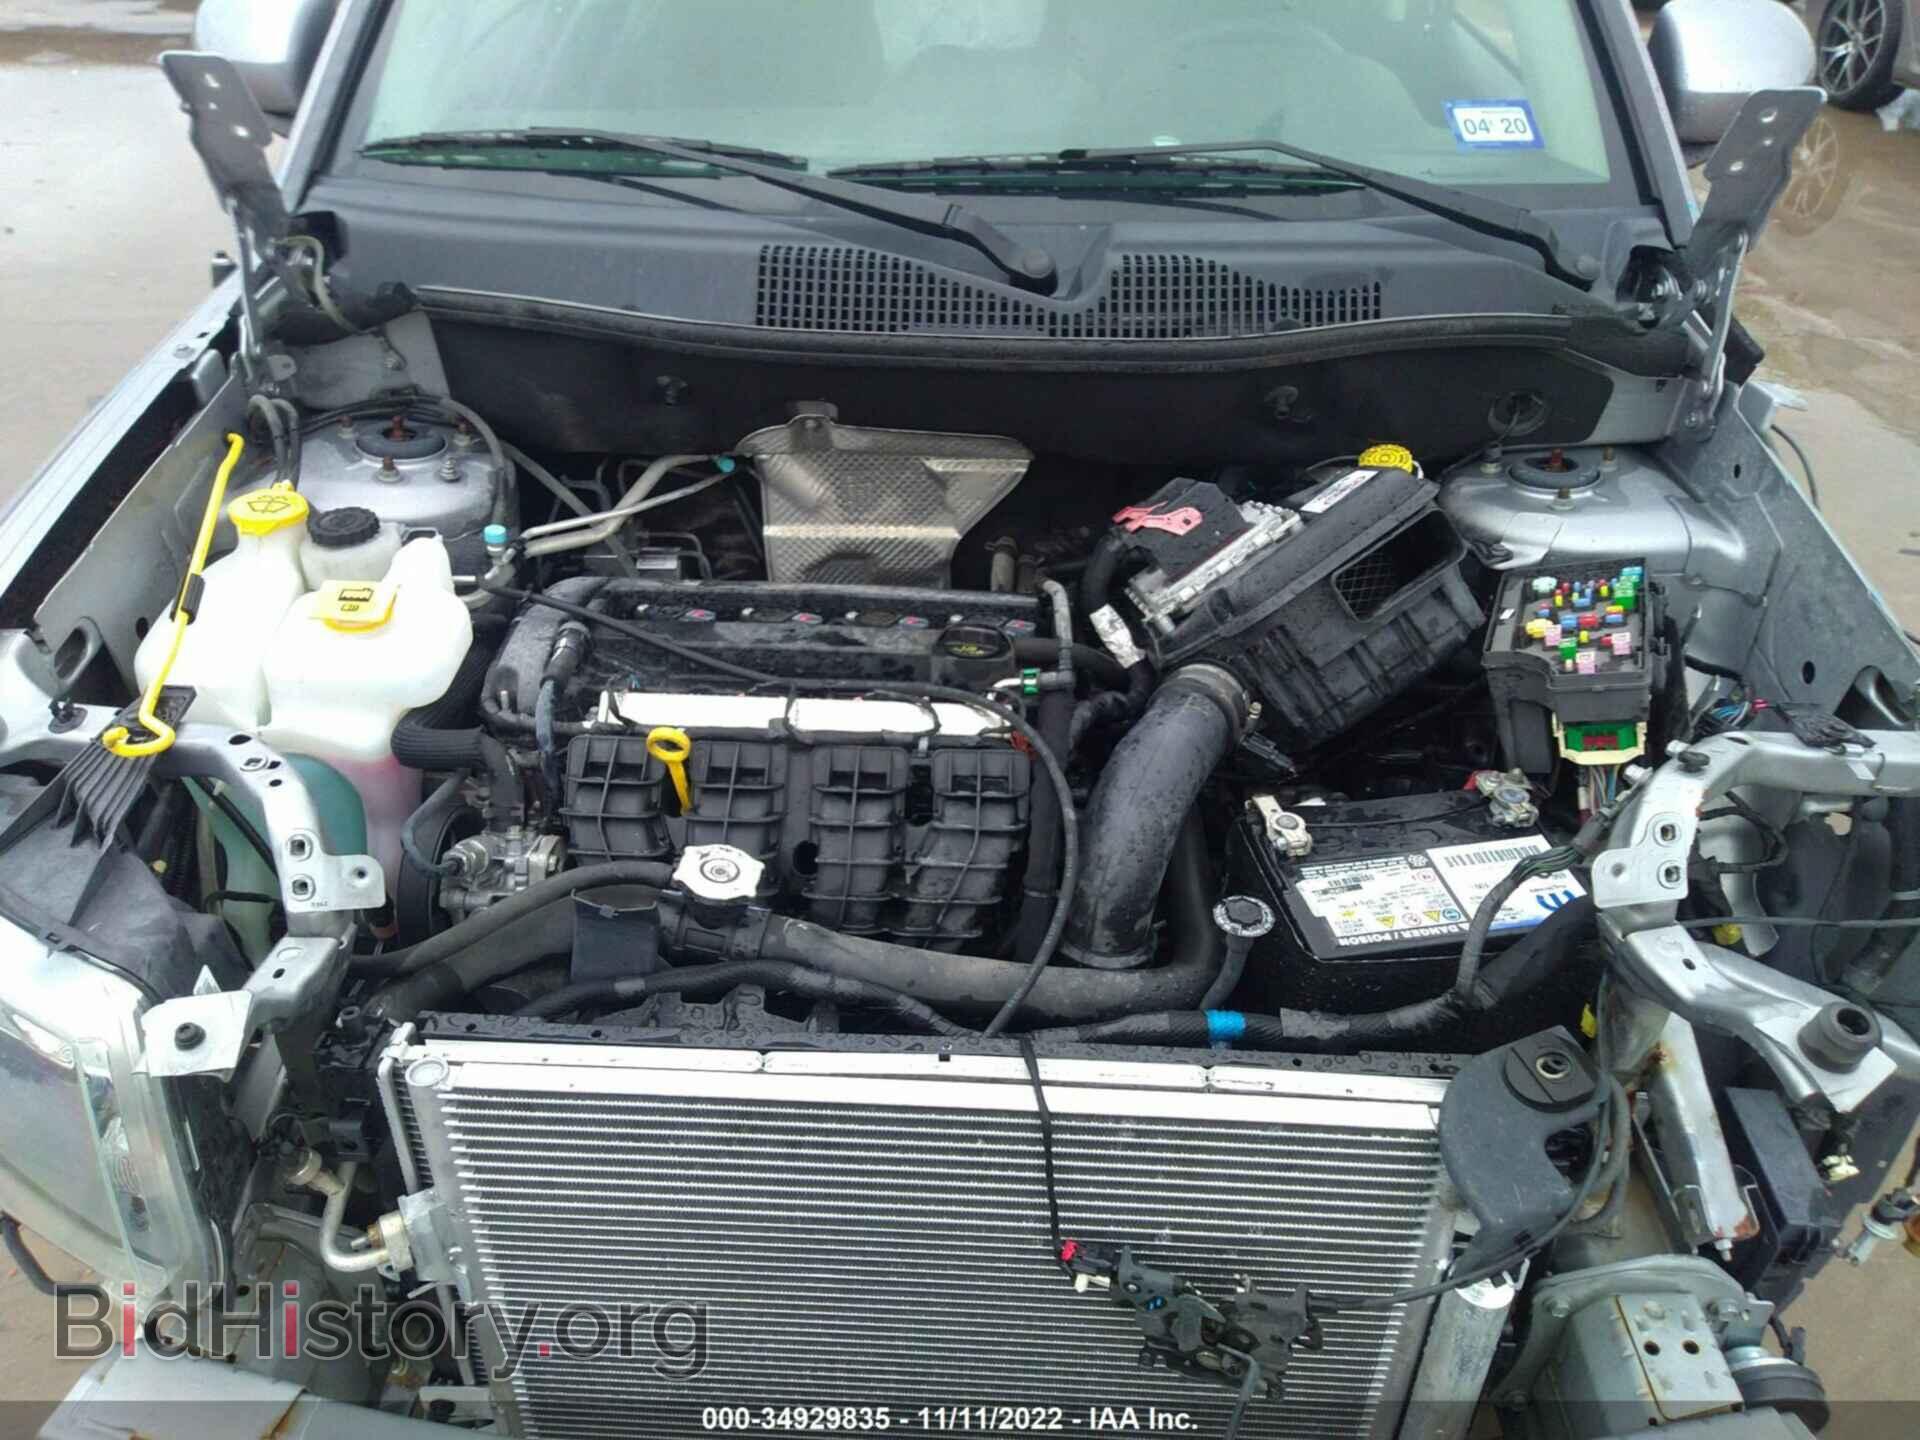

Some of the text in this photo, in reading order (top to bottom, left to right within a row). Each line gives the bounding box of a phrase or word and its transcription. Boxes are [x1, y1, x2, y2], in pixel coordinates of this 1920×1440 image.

[1463, 118, 1527, 135] 04 20
[1338, 932, 1392, 946] POISON
